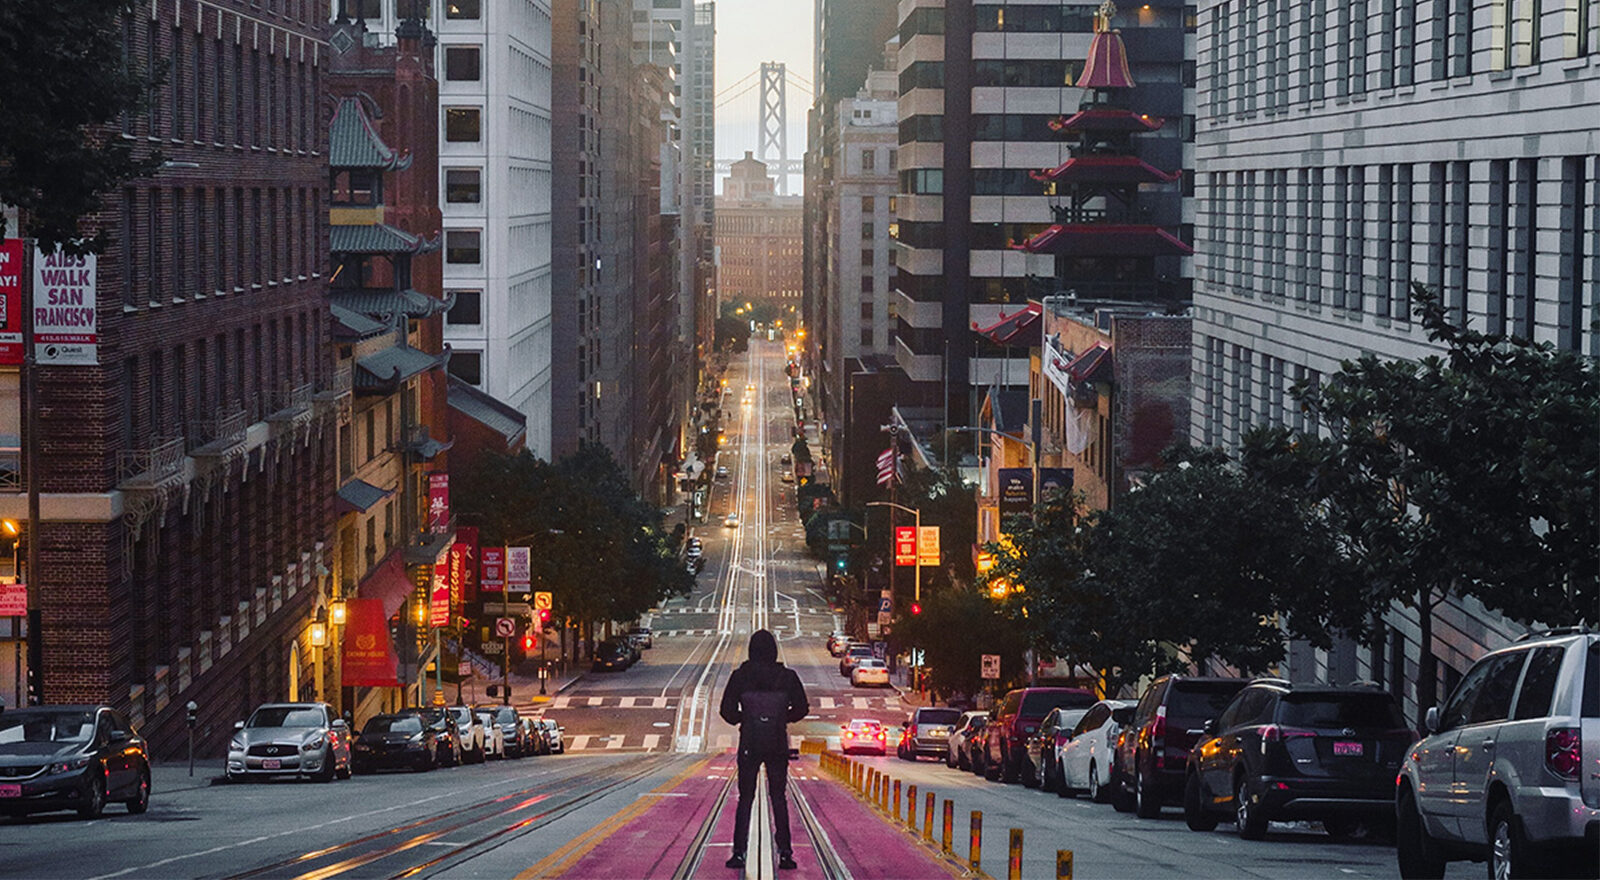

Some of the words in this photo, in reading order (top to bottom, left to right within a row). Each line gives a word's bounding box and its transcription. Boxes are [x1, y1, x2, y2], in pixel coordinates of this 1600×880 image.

[45, 251, 86, 268] AIDS
[41, 269, 90, 287] WALK
[48, 288, 83, 305] SAN
